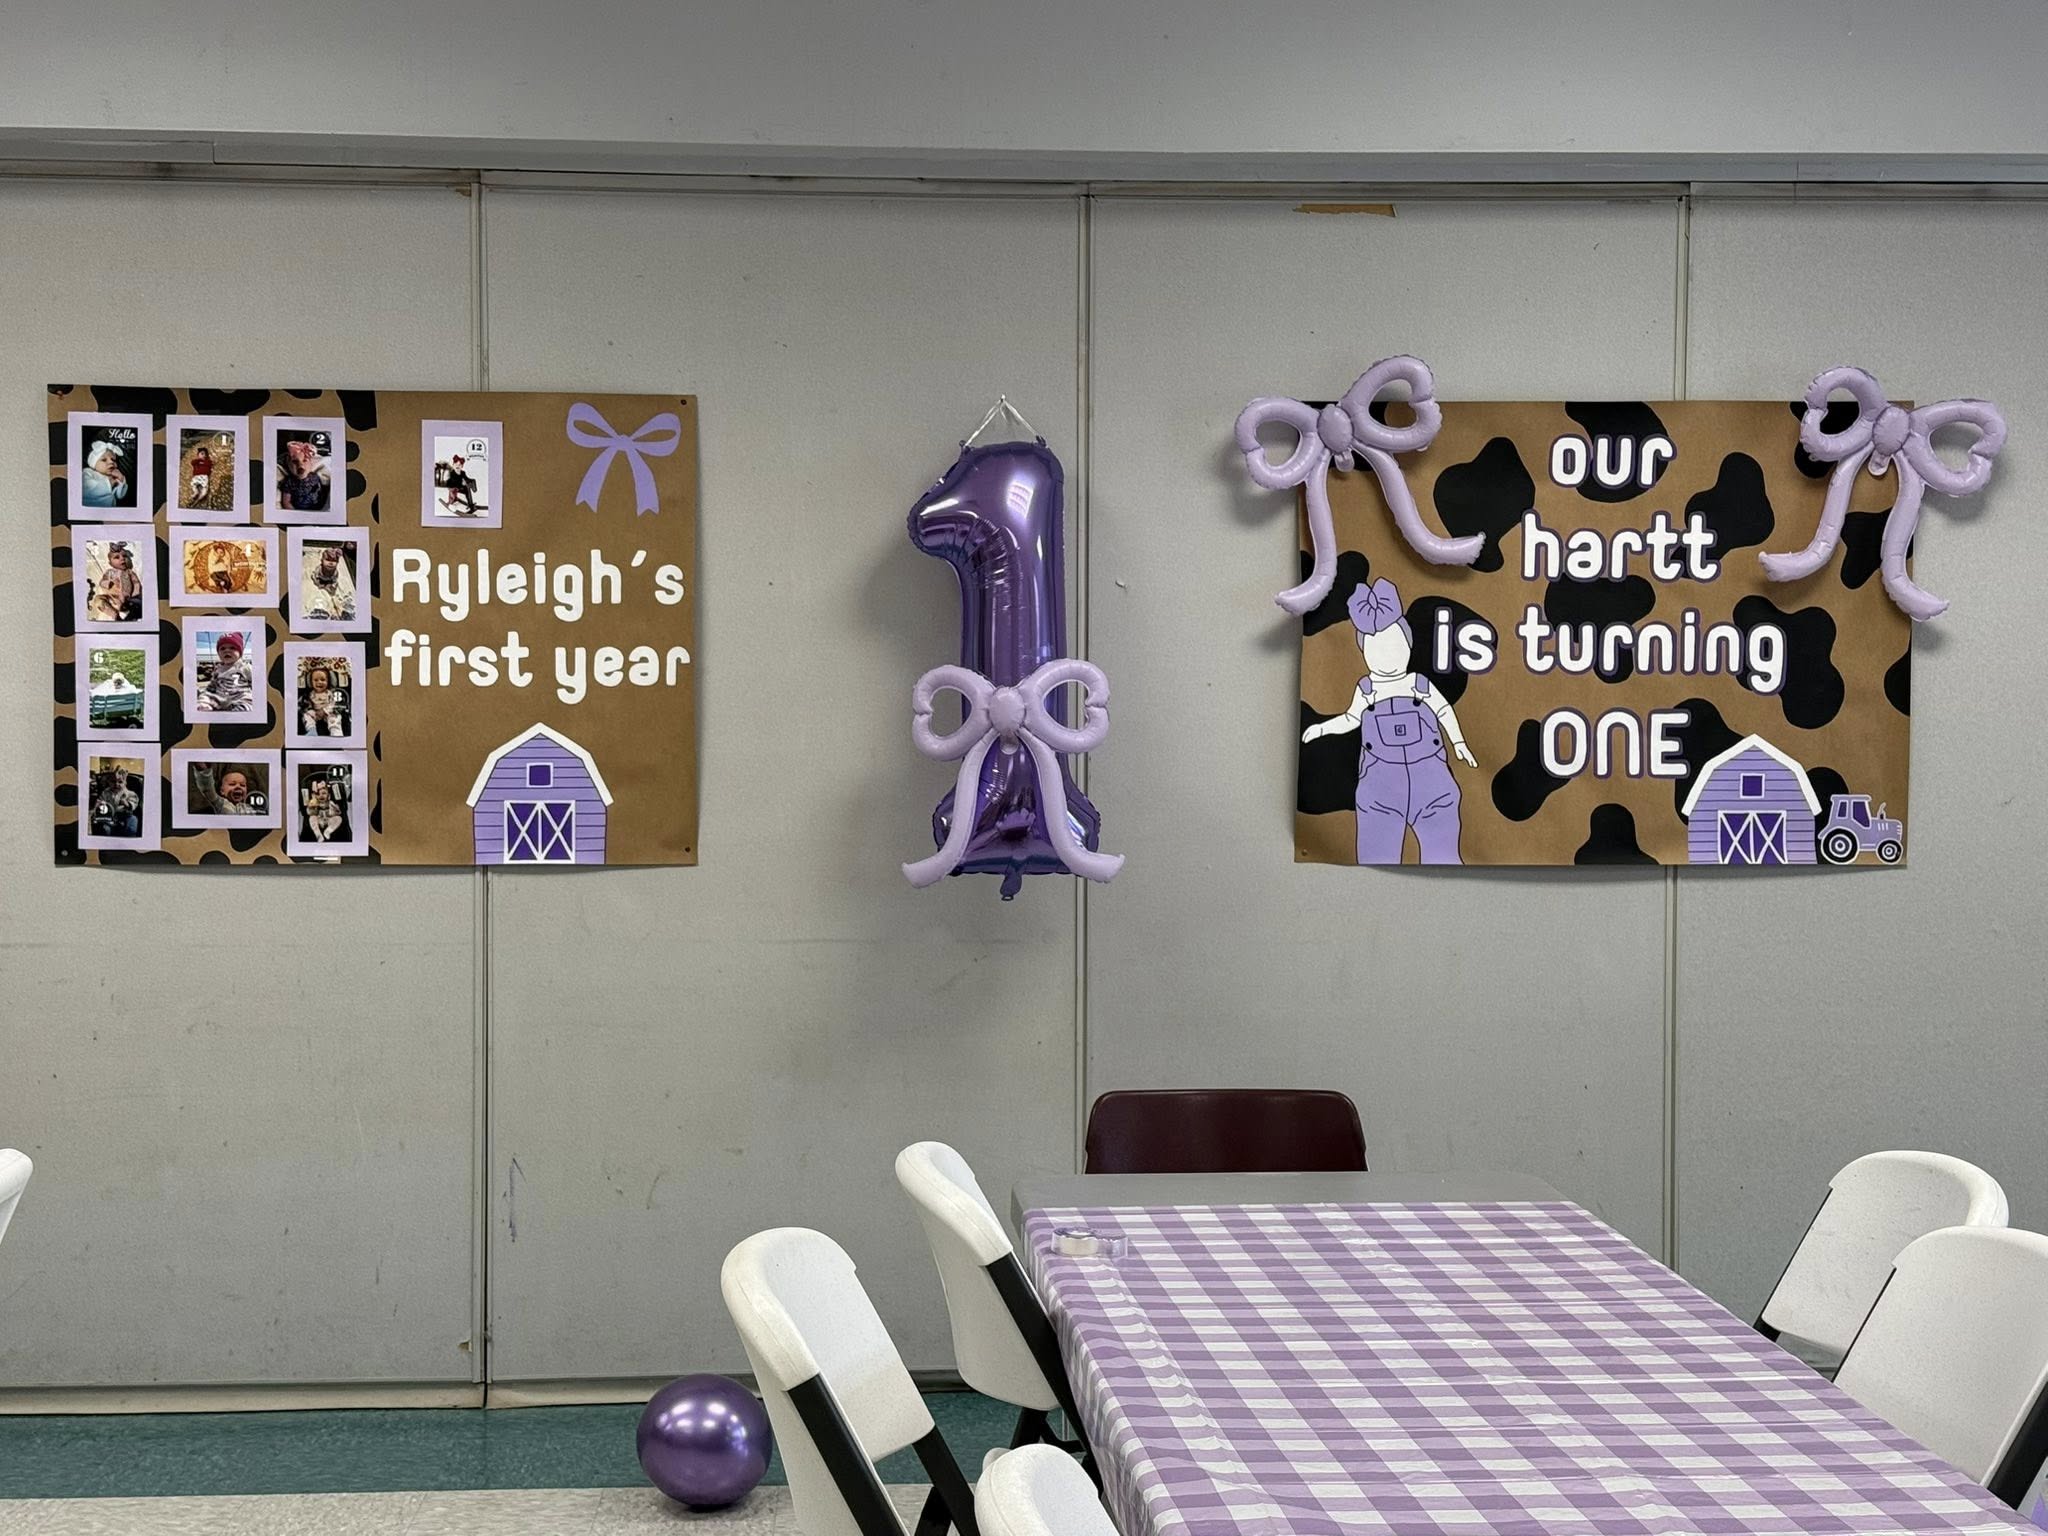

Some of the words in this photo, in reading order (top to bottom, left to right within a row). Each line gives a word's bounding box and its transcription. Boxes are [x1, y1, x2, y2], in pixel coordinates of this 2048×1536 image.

[108, 428, 136, 440] Hello
[316, 433, 326, 445] 2
[471, 443, 483, 451] 12
[1550, 434, 1675, 487] our
[1521, 510, 1721, 582] hartt
[392, 548, 685, 622] Ryleigh's
[1434, 605, 1498, 674] is
[1517, 604, 1788, 695] turning
[93, 652, 104, 664] 6
[384, 628, 534, 688] first
[554, 646, 692, 705] year
[231, 674, 241, 685] 7
[333, 691, 343, 702] 8
[1539, 707, 1695, 780] ONE
[249, 796, 265, 806] 10
[99, 804, 109, 815] 9
